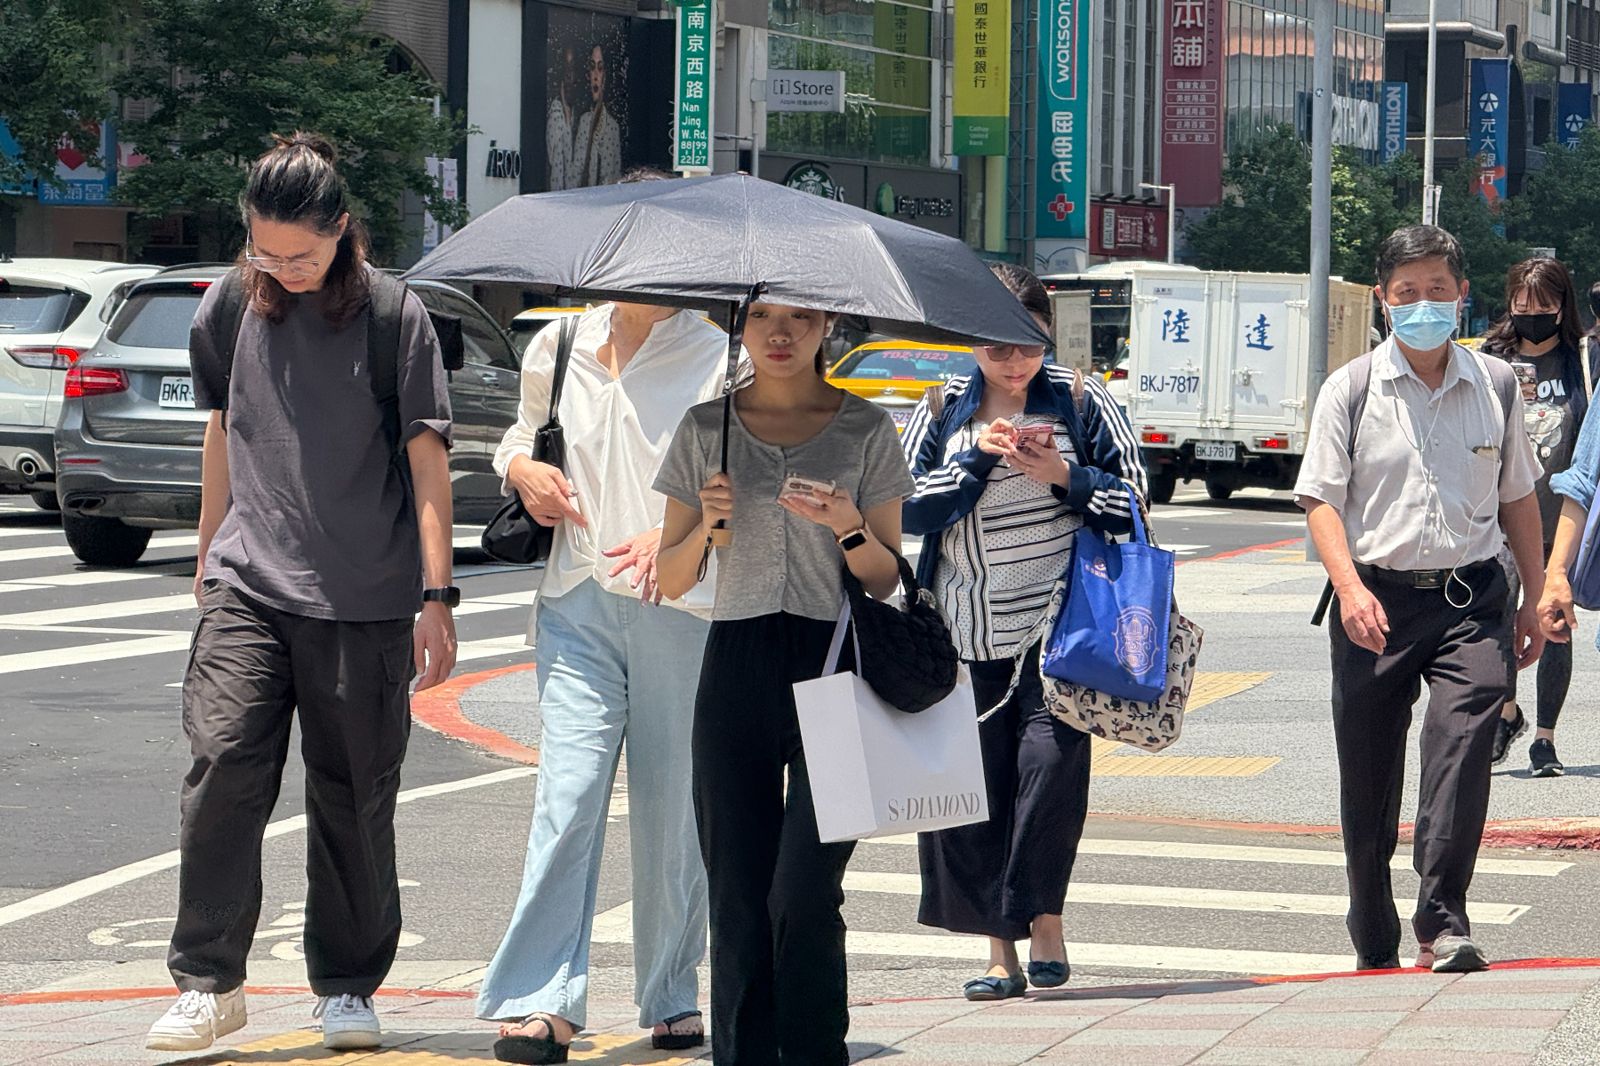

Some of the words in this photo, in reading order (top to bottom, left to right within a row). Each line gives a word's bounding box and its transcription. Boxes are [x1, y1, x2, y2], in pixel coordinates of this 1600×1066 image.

[974, 2, 988, 88] 國泰世華銀行
[1056, 0, 1071, 83] watson
[686, 10, 706, 98] 南京西路
[682, 102, 700, 112] Nan
[681, 115, 702, 129] Jing
[681, 129, 692, 140] W.
[693, 129, 708, 140] Rd.
[681, 141, 692, 150] 88
[695, 141, 707, 150] 99
[1051, 111, 1074, 183] 屈臣氏
[1480, 118, 1497, 185] 元大銀行
[680, 155, 692, 164] 22
[695, 155, 707, 164] 27
[161, 383, 195, 402] BKR-
[1140, 375, 1200, 393] BKJ-7817
[1196, 446, 1235, 459] BKJ-7817
